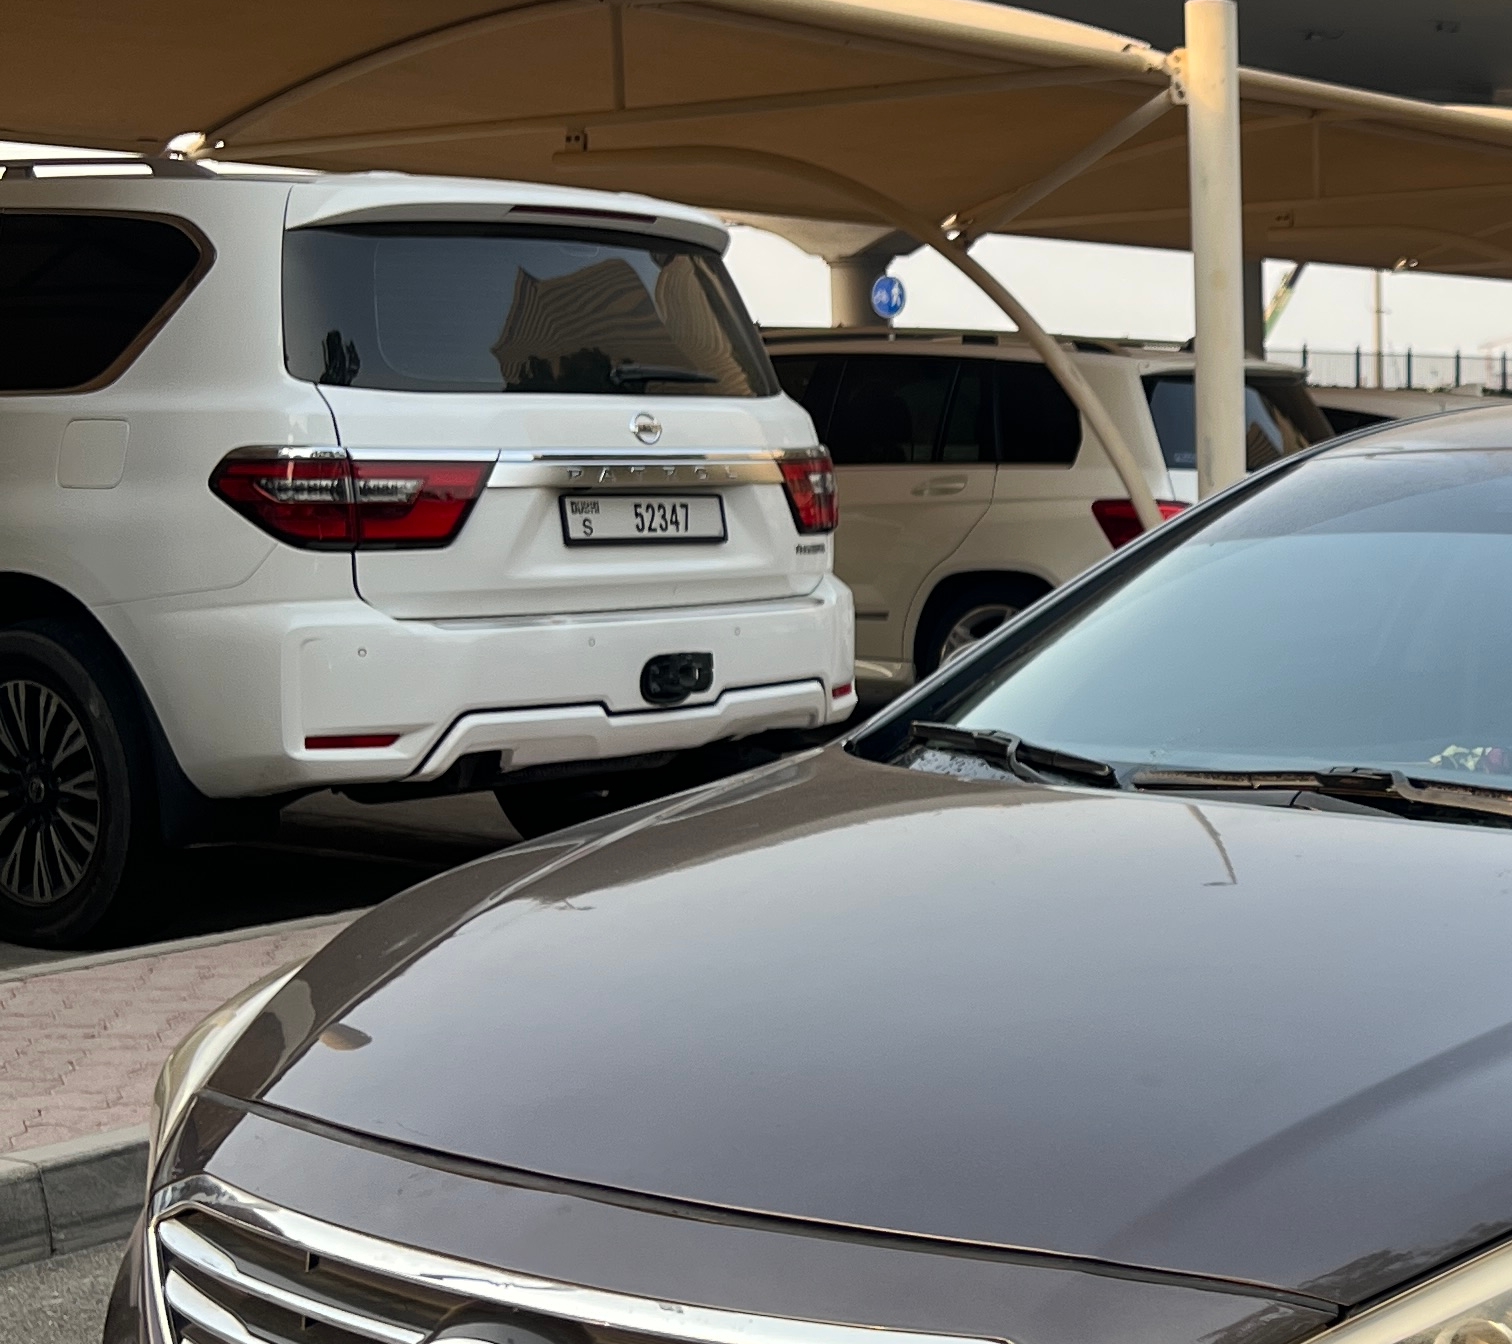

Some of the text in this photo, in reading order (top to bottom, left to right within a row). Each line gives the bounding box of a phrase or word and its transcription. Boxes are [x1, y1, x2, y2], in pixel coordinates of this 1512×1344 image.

[567, 466, 738, 484] PATROL
[633, 502, 689, 533] 52347
[582, 518, 594, 537] S
